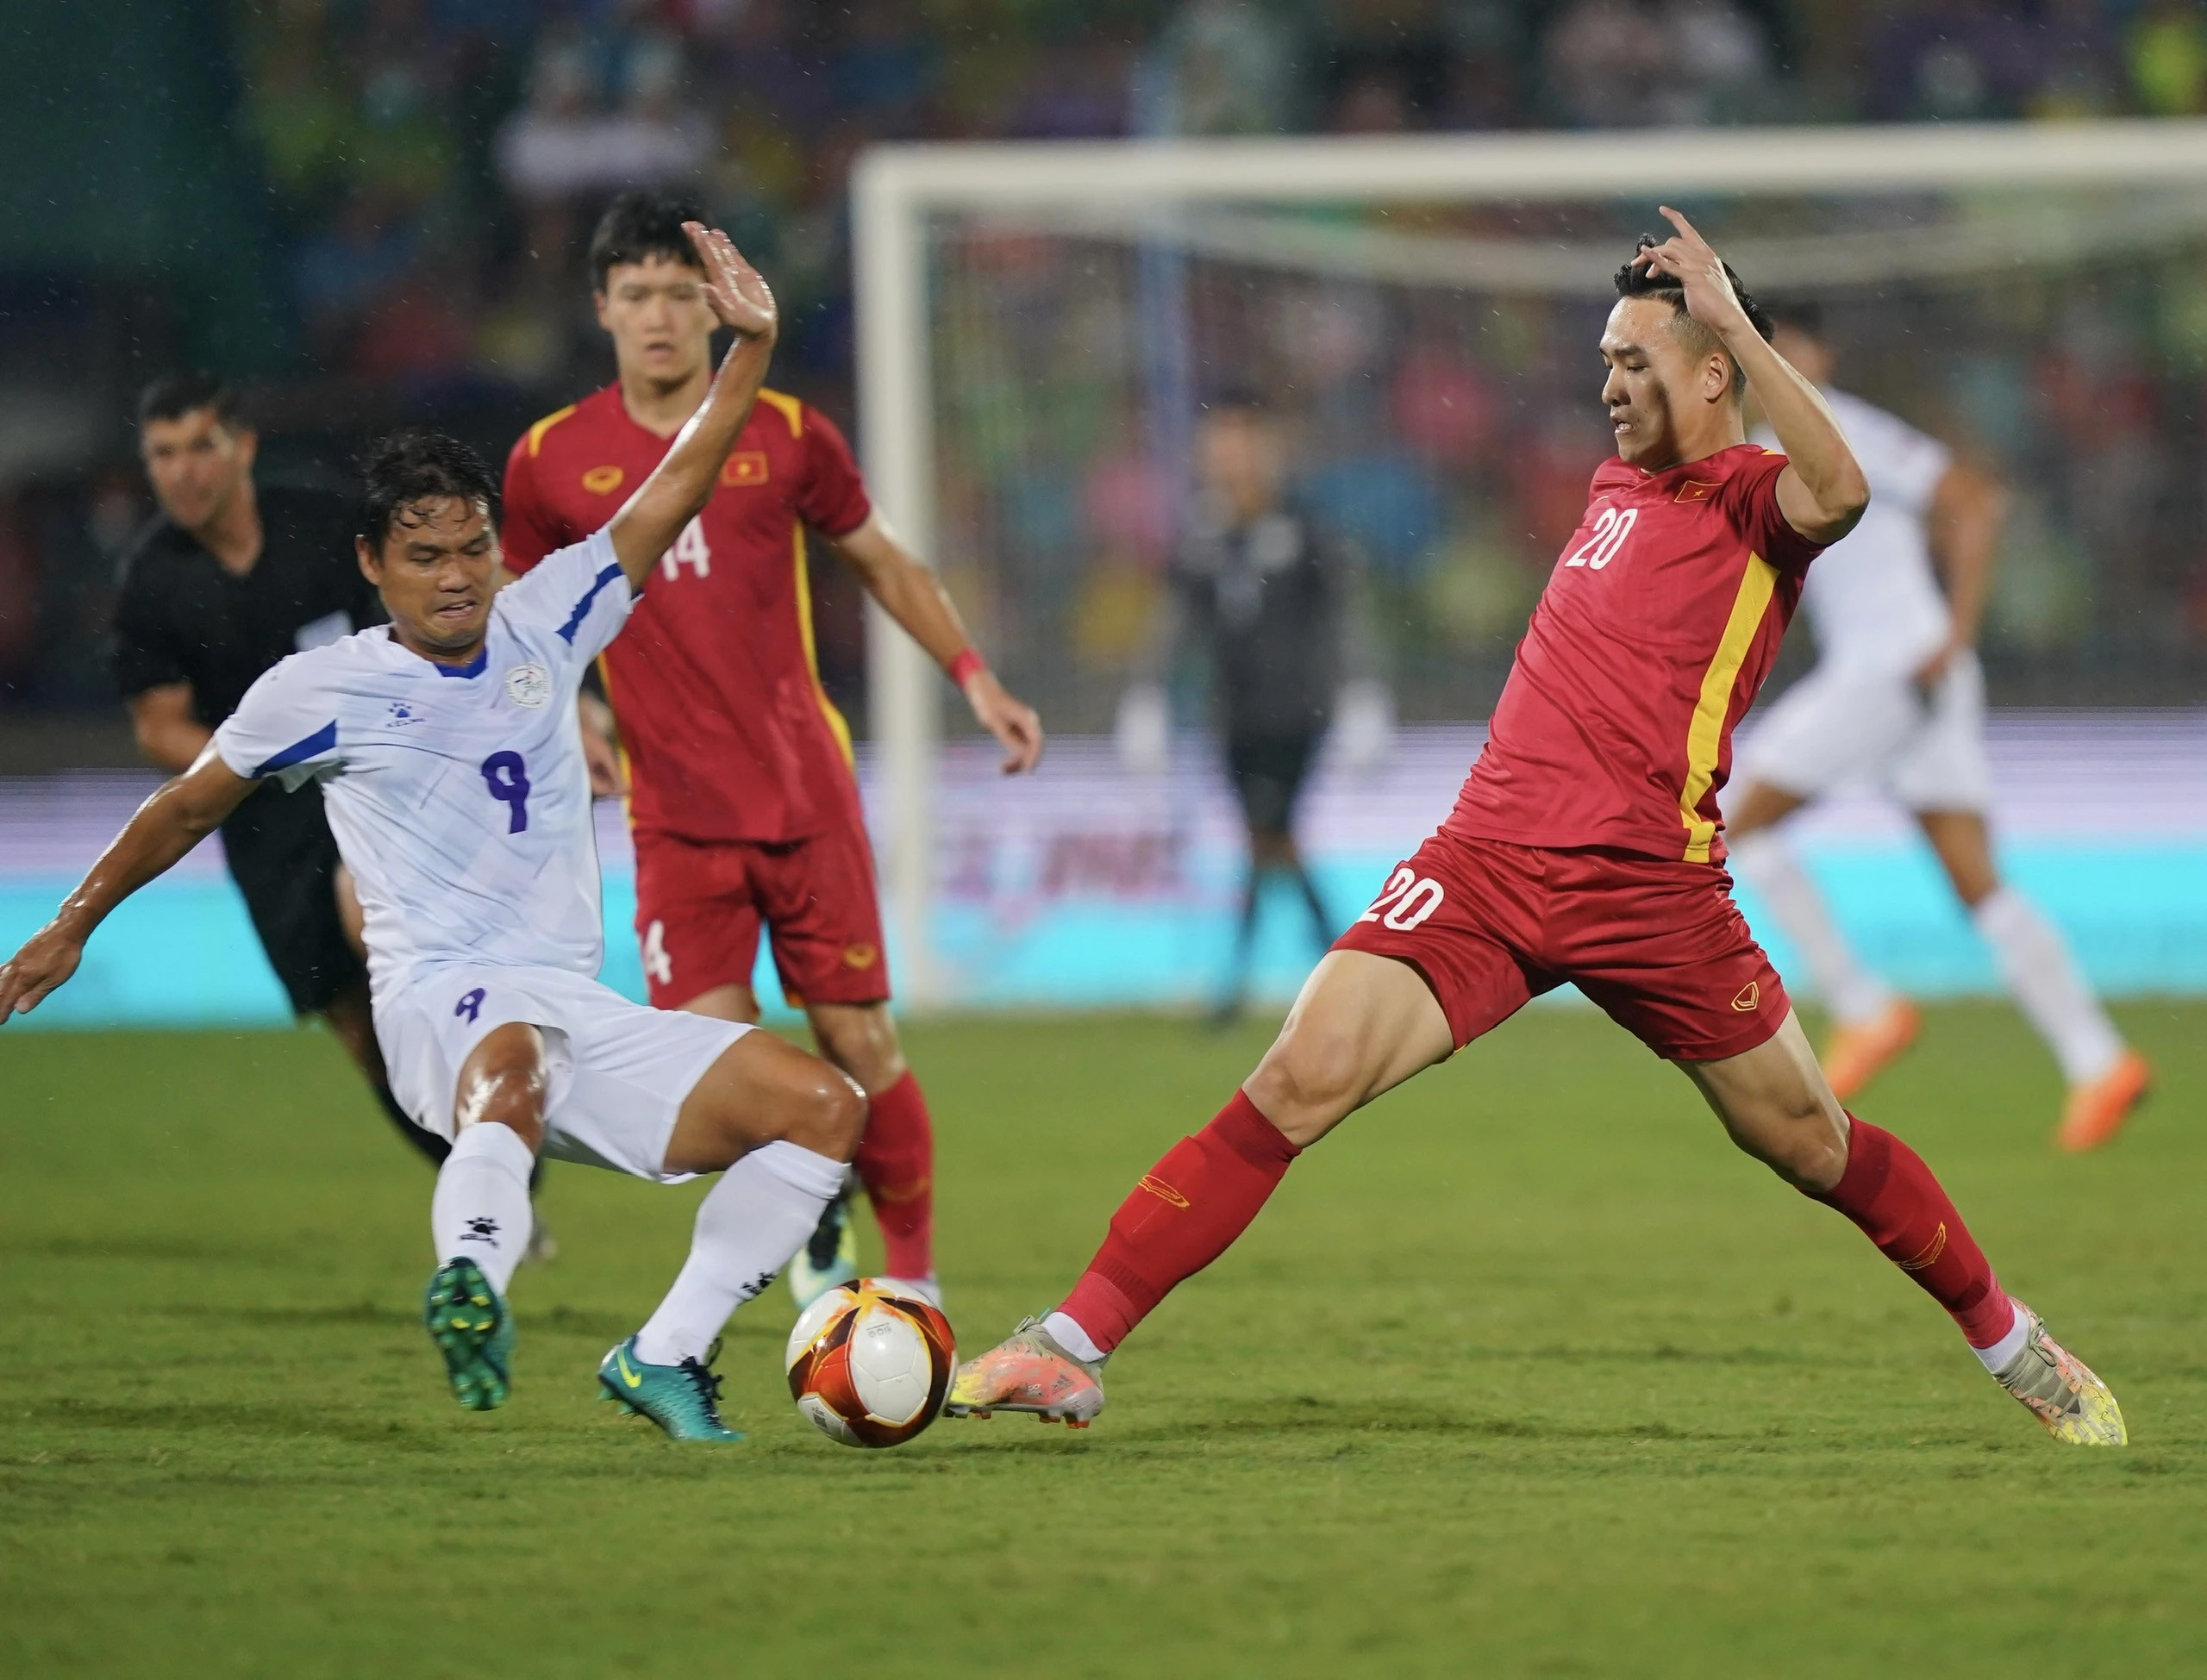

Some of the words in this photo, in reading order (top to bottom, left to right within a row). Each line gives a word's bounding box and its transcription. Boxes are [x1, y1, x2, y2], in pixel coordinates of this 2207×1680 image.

[1565, 507, 1638, 570] 20
[481, 750, 530, 834] 9
[1357, 867, 1445, 931] 20
